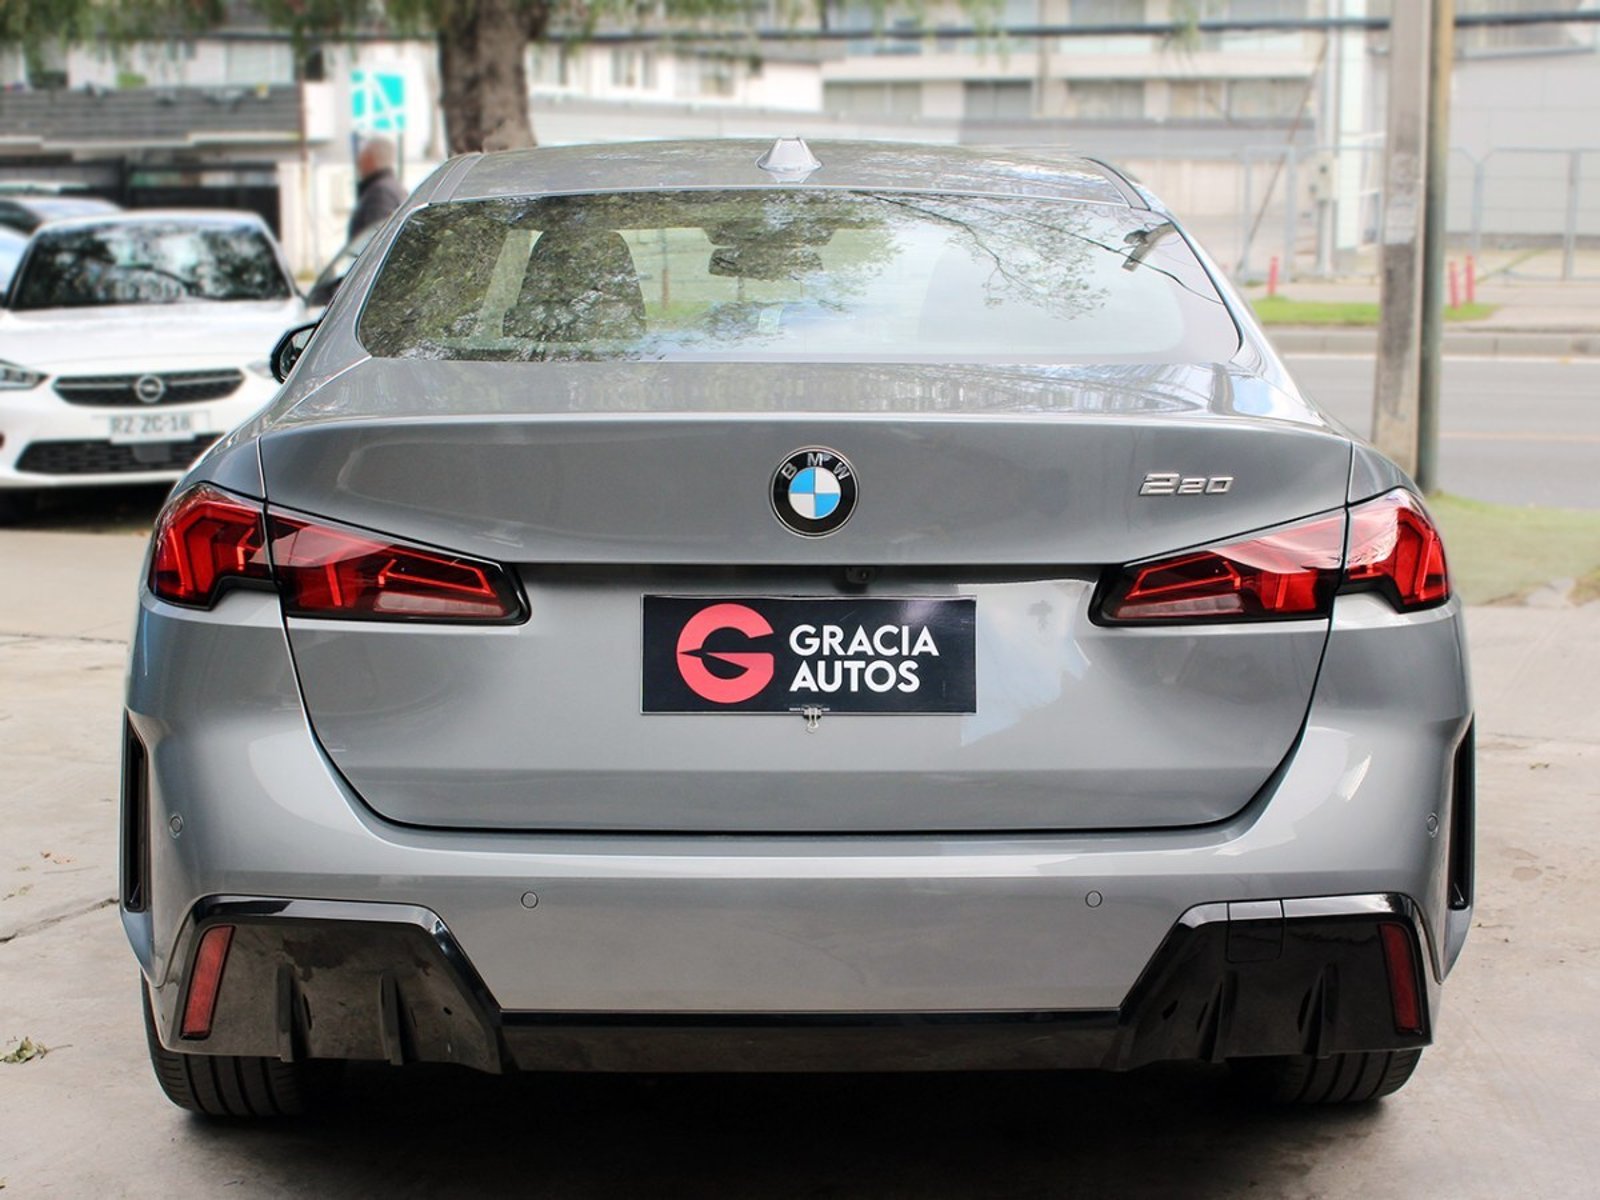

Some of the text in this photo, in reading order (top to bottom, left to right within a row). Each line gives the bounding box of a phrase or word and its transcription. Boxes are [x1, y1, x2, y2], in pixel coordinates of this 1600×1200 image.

[781, 452, 850, 480] BMW
[1139, 473, 1234, 494] 220
[789, 624, 939, 656] GRACIA
[789, 660, 921, 693] AUTOS
